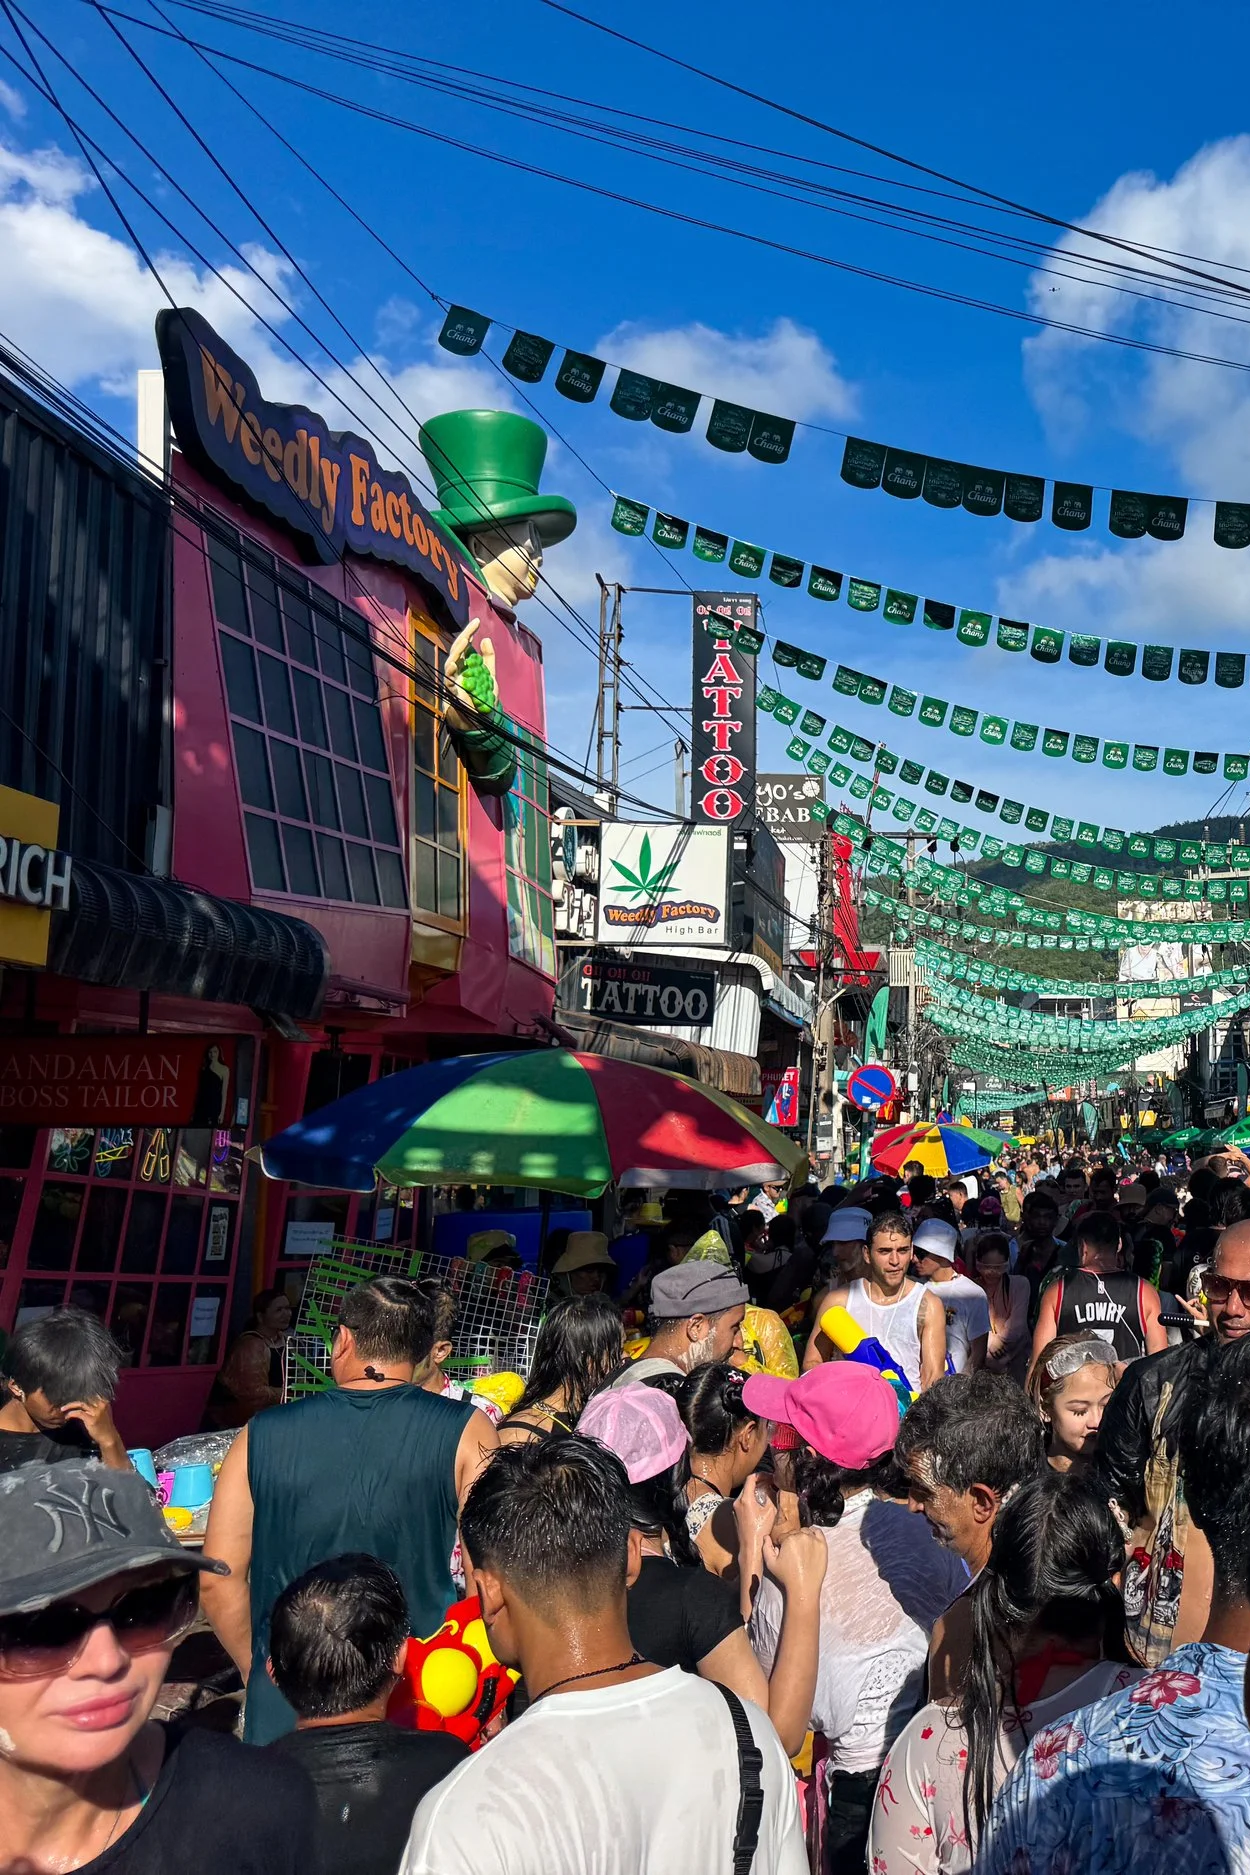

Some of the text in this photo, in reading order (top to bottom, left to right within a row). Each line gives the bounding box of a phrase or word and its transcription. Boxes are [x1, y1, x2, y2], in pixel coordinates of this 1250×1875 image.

[446, 328, 477, 347] Chang
[561, 372, 593, 394] Chang
[657, 405, 689, 425] Chang
[753, 436, 785, 455] Chang
[200, 343, 460, 603] Weedly Factory
[887, 472, 918, 489] Chang
[967, 490, 998, 507] Chang
[1056, 506, 1086, 521] Chang
[1151, 516, 1181, 531] Chang
[657, 528, 683, 543] Chang
[733, 556, 758, 572] Chang
[812, 581, 836, 596] Chang
[887, 605, 911, 619] Chang
[961, 626, 985, 640] Chang
[1034, 643, 1058, 656] Chang
[1108, 656, 1131, 670] Chang
[756, 783, 806, 807] yo's
[756, 807, 811, 823] EBAB
[608, 903, 716, 924] Weedly Factory
[666, 926, 719, 936] High Bar
[581, 977, 709, 1020] TATTOO
[1, 1053, 182, 1082] ANDAMAN
[762, 1071, 795, 1082] PHUKET
[0, 1084, 181, 1109] BOSS TAILOR
[1074, 1302, 1127, 1325] LOWRY
